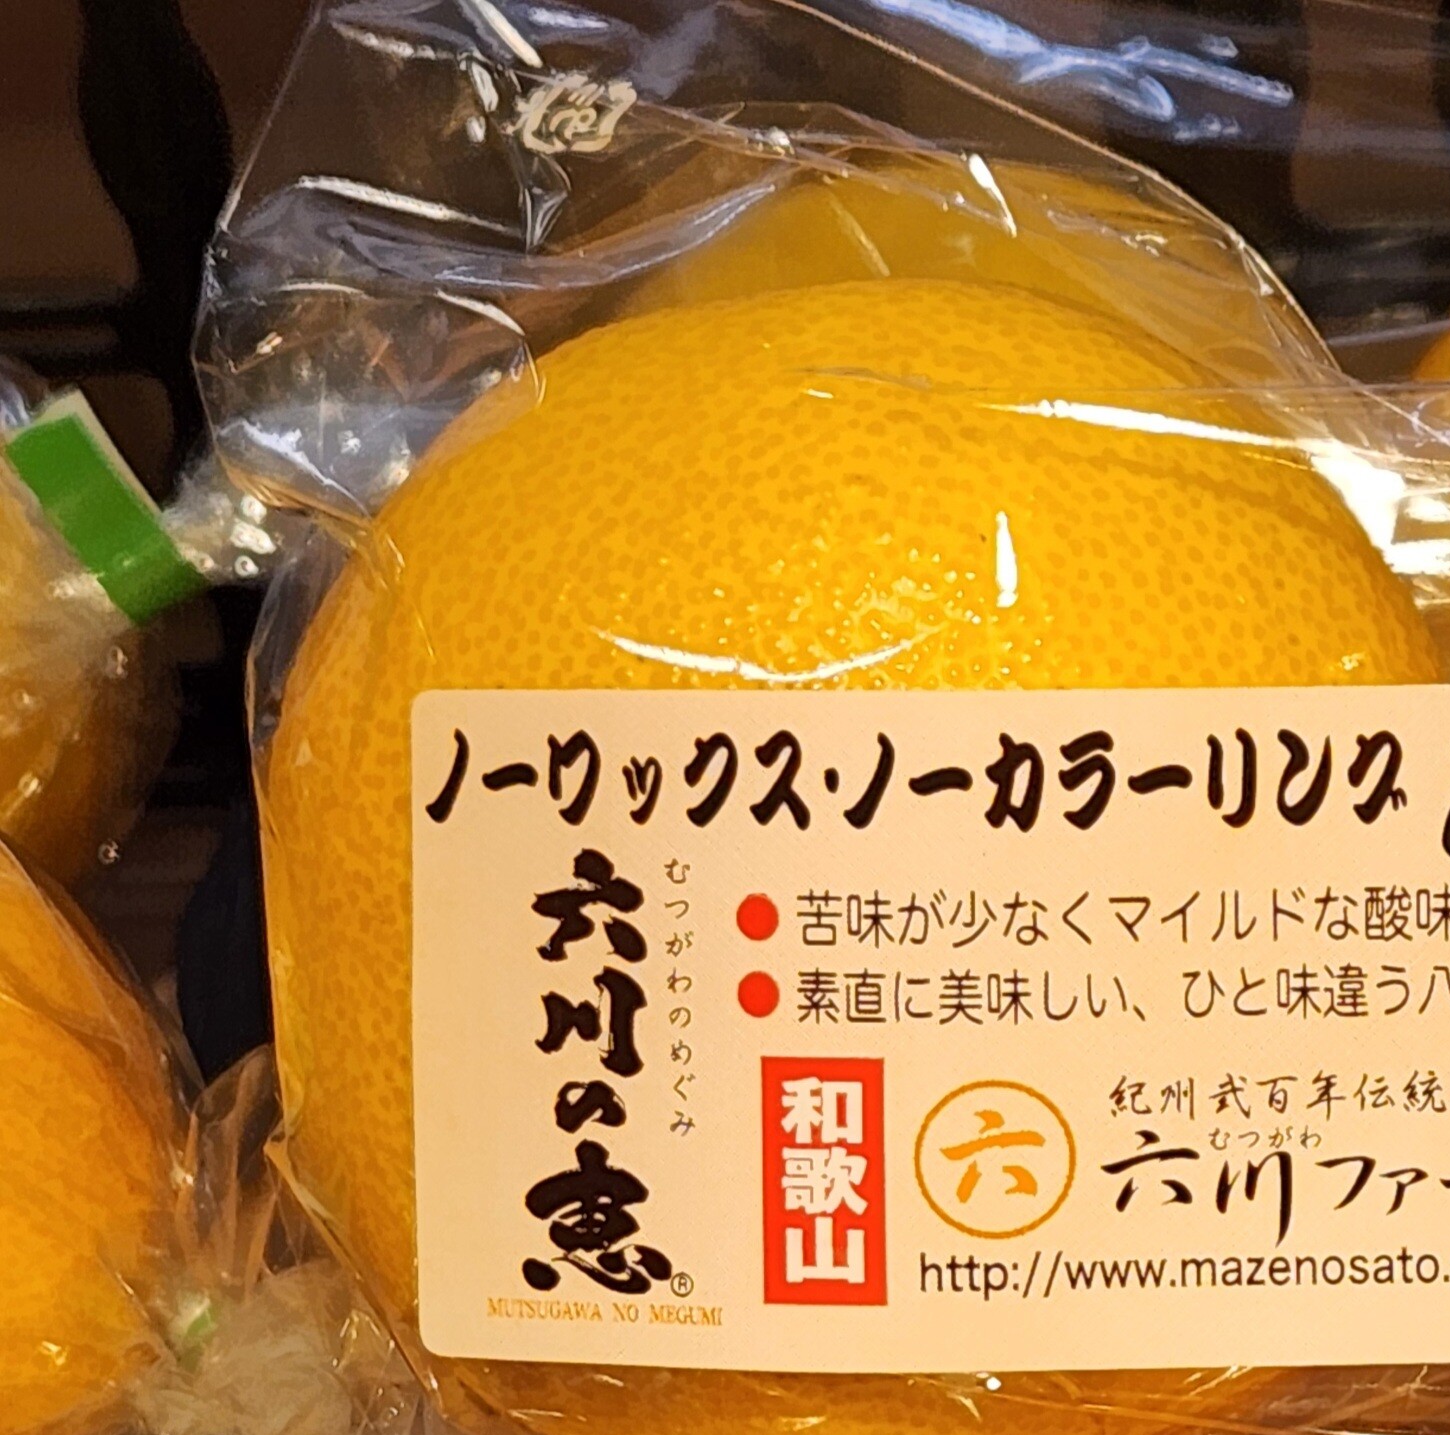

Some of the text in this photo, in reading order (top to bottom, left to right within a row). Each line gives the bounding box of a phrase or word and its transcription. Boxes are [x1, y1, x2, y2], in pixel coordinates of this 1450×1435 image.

[662, 856, 698, 1137] むつがわのめぐみ
[780, 1076, 868, 1284] 和歌山
[940, 1109, 1046, 1204] 六
[1207, 1124, 1322, 1151] むつがわ
[487, 1297, 723, 1327] MUTSUGAWA NO MEGUMI
